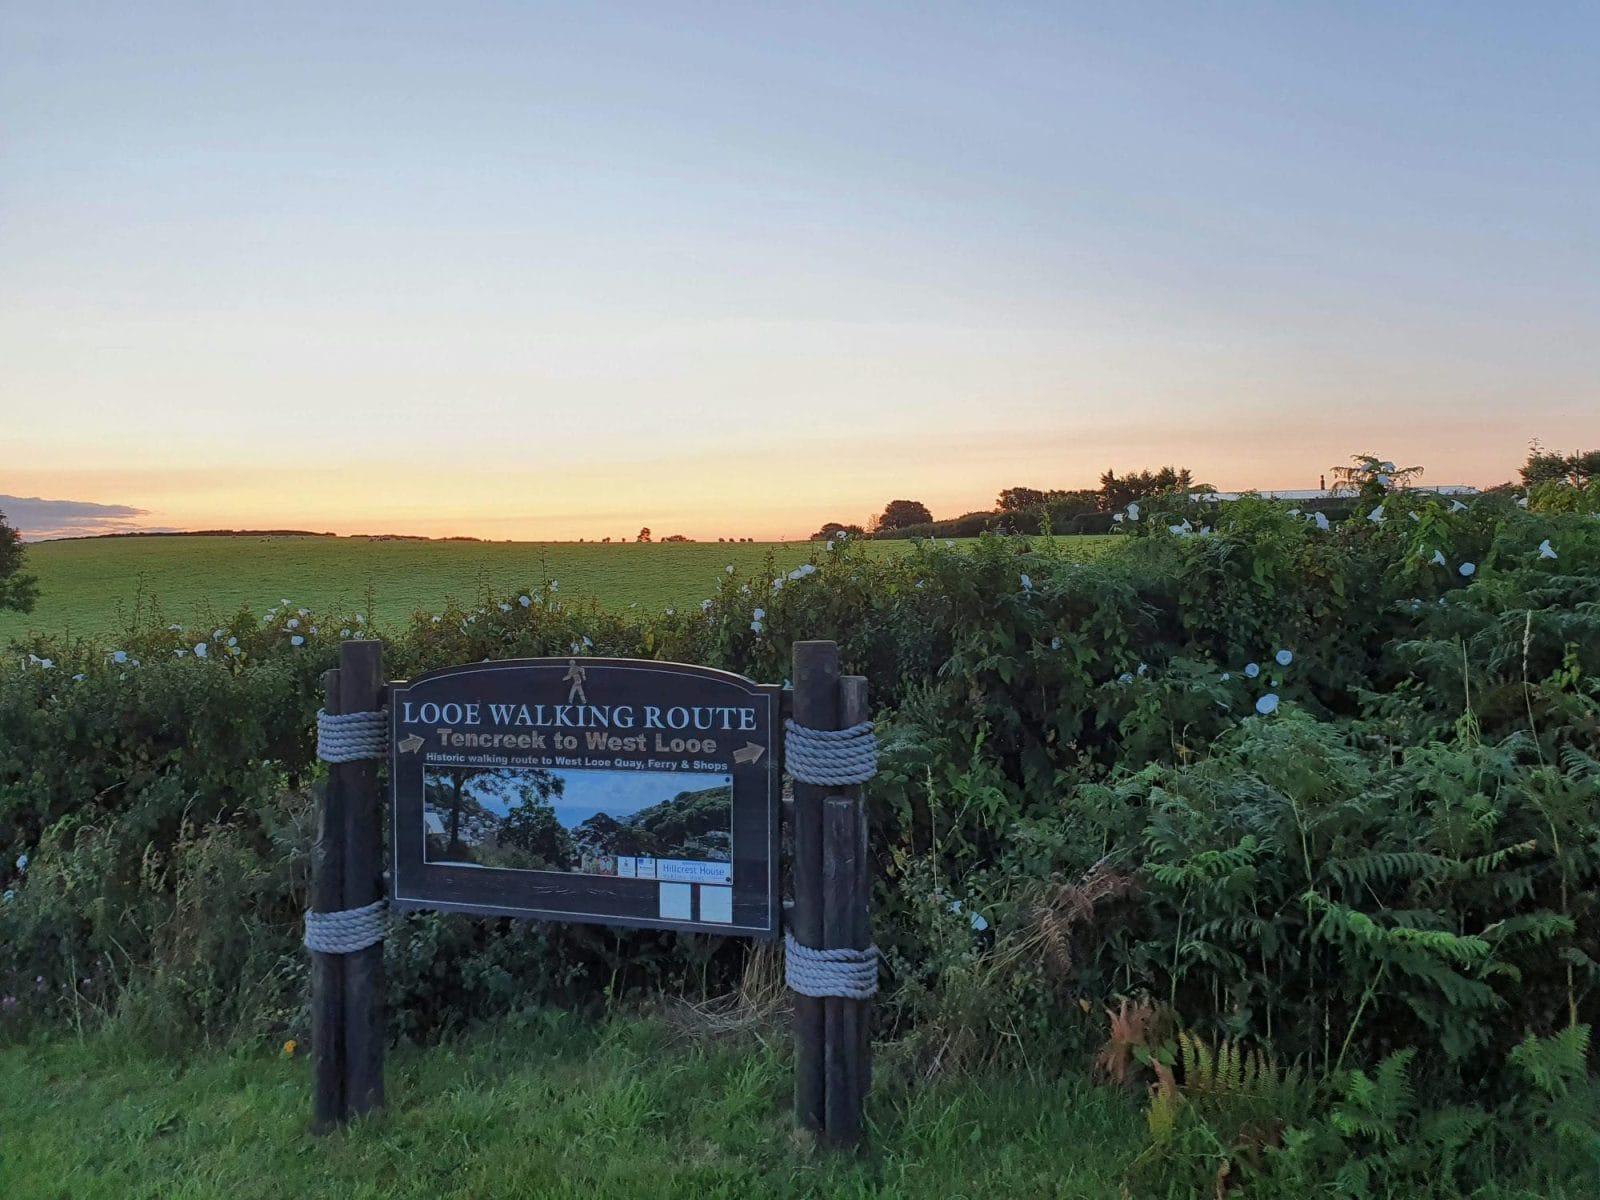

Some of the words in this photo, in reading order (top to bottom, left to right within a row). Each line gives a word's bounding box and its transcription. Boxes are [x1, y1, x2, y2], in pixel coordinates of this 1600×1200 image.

[402, 702, 481, 725] LOOE
[488, 703, 634, 728] WALKING
[643, 706, 757, 730] ROUTE
[436, 728, 547, 749] Tencreek
[553, 731, 578, 750] to
[585, 731, 647, 752] West
[655, 733, 717, 754] Looe
[426, 752, 465, 762] Historic
[468, 754, 508, 765] walking
[511, 755, 539, 765] route
[542, 756, 552, 765] to
[555, 756, 582, 766] West
[585, 758, 611, 767] Looe
[614, 758, 645, 769] Quay,
[648, 759, 678, 770] Ferry
[681, 760, 690, 769] &
[693, 760, 728, 772] Shops
[663, 864, 697, 874] Hillcrest
[700, 865, 725, 876] House
